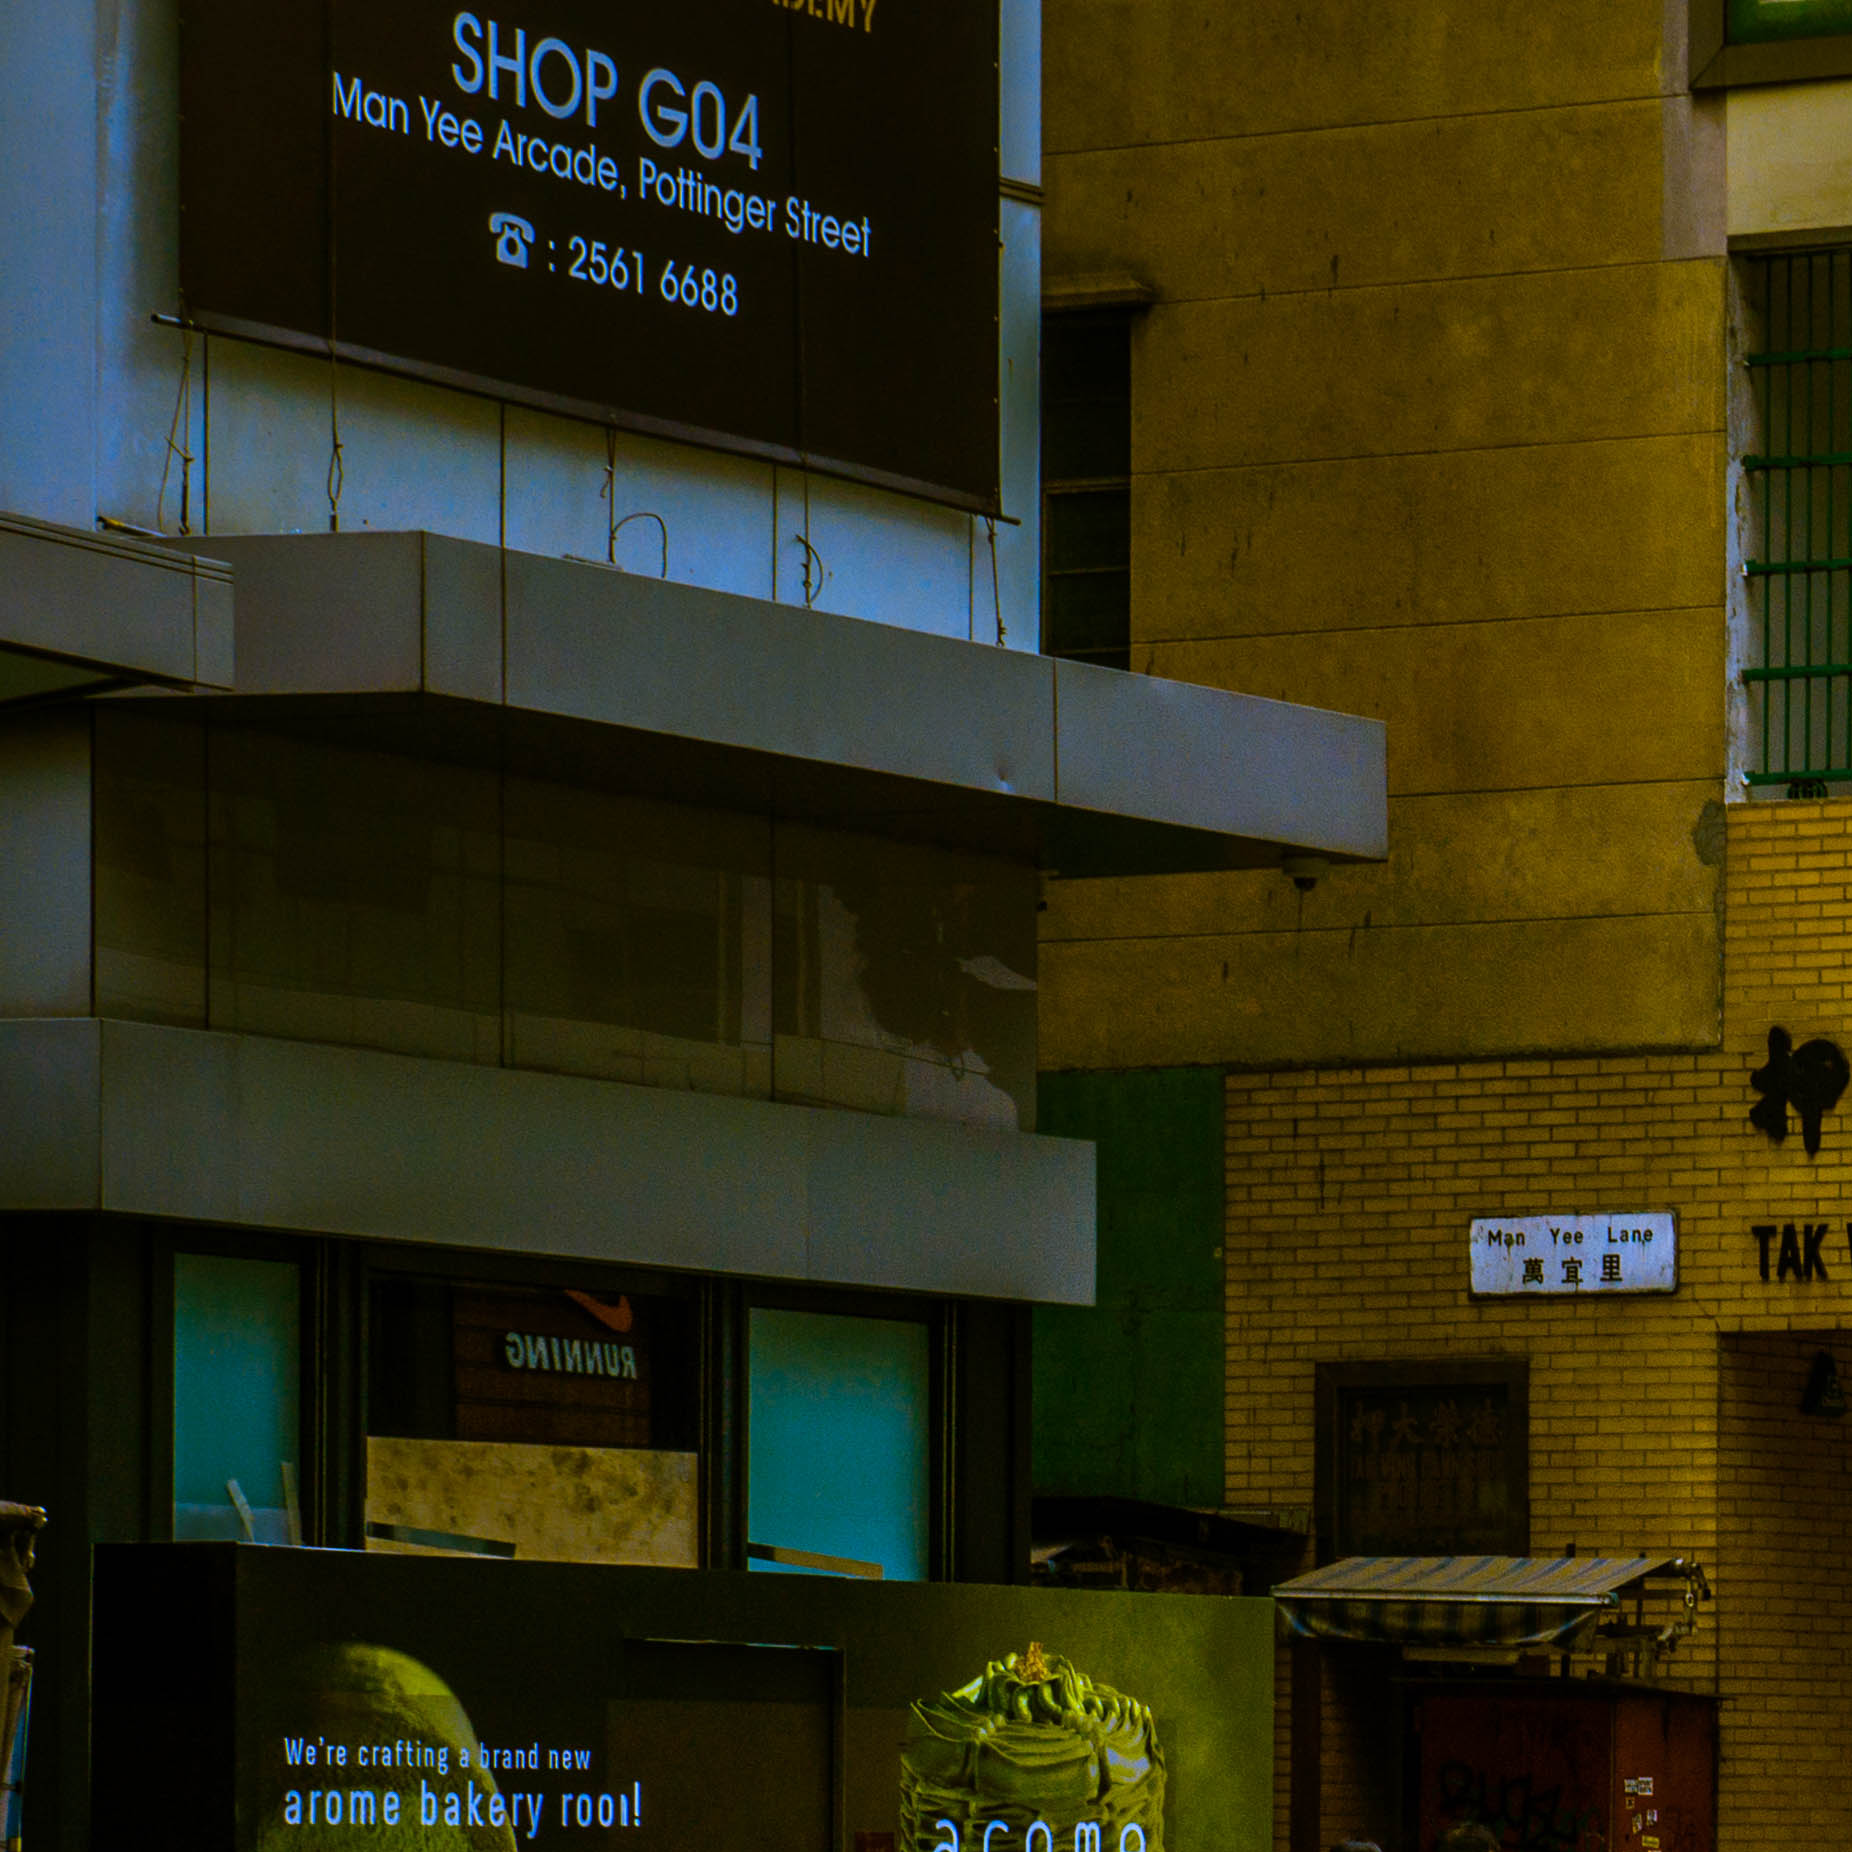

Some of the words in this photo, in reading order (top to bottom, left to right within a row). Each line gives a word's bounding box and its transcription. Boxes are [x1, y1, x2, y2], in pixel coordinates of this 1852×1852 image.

[451, 11, 618, 128] SHOP
[638, 67, 763, 171] G04
[332, 71, 409, 135] Man
[419, 95, 484, 154] Yee
[492, 119, 628, 200] Arcade,
[639, 156, 776, 235] Pottinger
[785, 197, 873, 258] Street
[567, 235, 646, 295] 2561
[659, 260, 740, 318] 6688
[1488, 1229, 1526, 1248] Man
[1550, 1228, 1584, 1246] Yee
[1607, 1226, 1654, 1245] Lane
[1751, 1222, 1830, 1282] TAK
[1521, 1254, 1624, 1285] 萬宜里
[283, 1736, 348, 1768] We're
[358, 1738, 450, 1775] crafting
[459, 1746, 471, 1769] a
[480, 1741, 540, 1771] brand
[548, 1747, 592, 1771] new
[284, 1786, 402, 1826] arome
[419, 1780, 545, 1839] bakery
